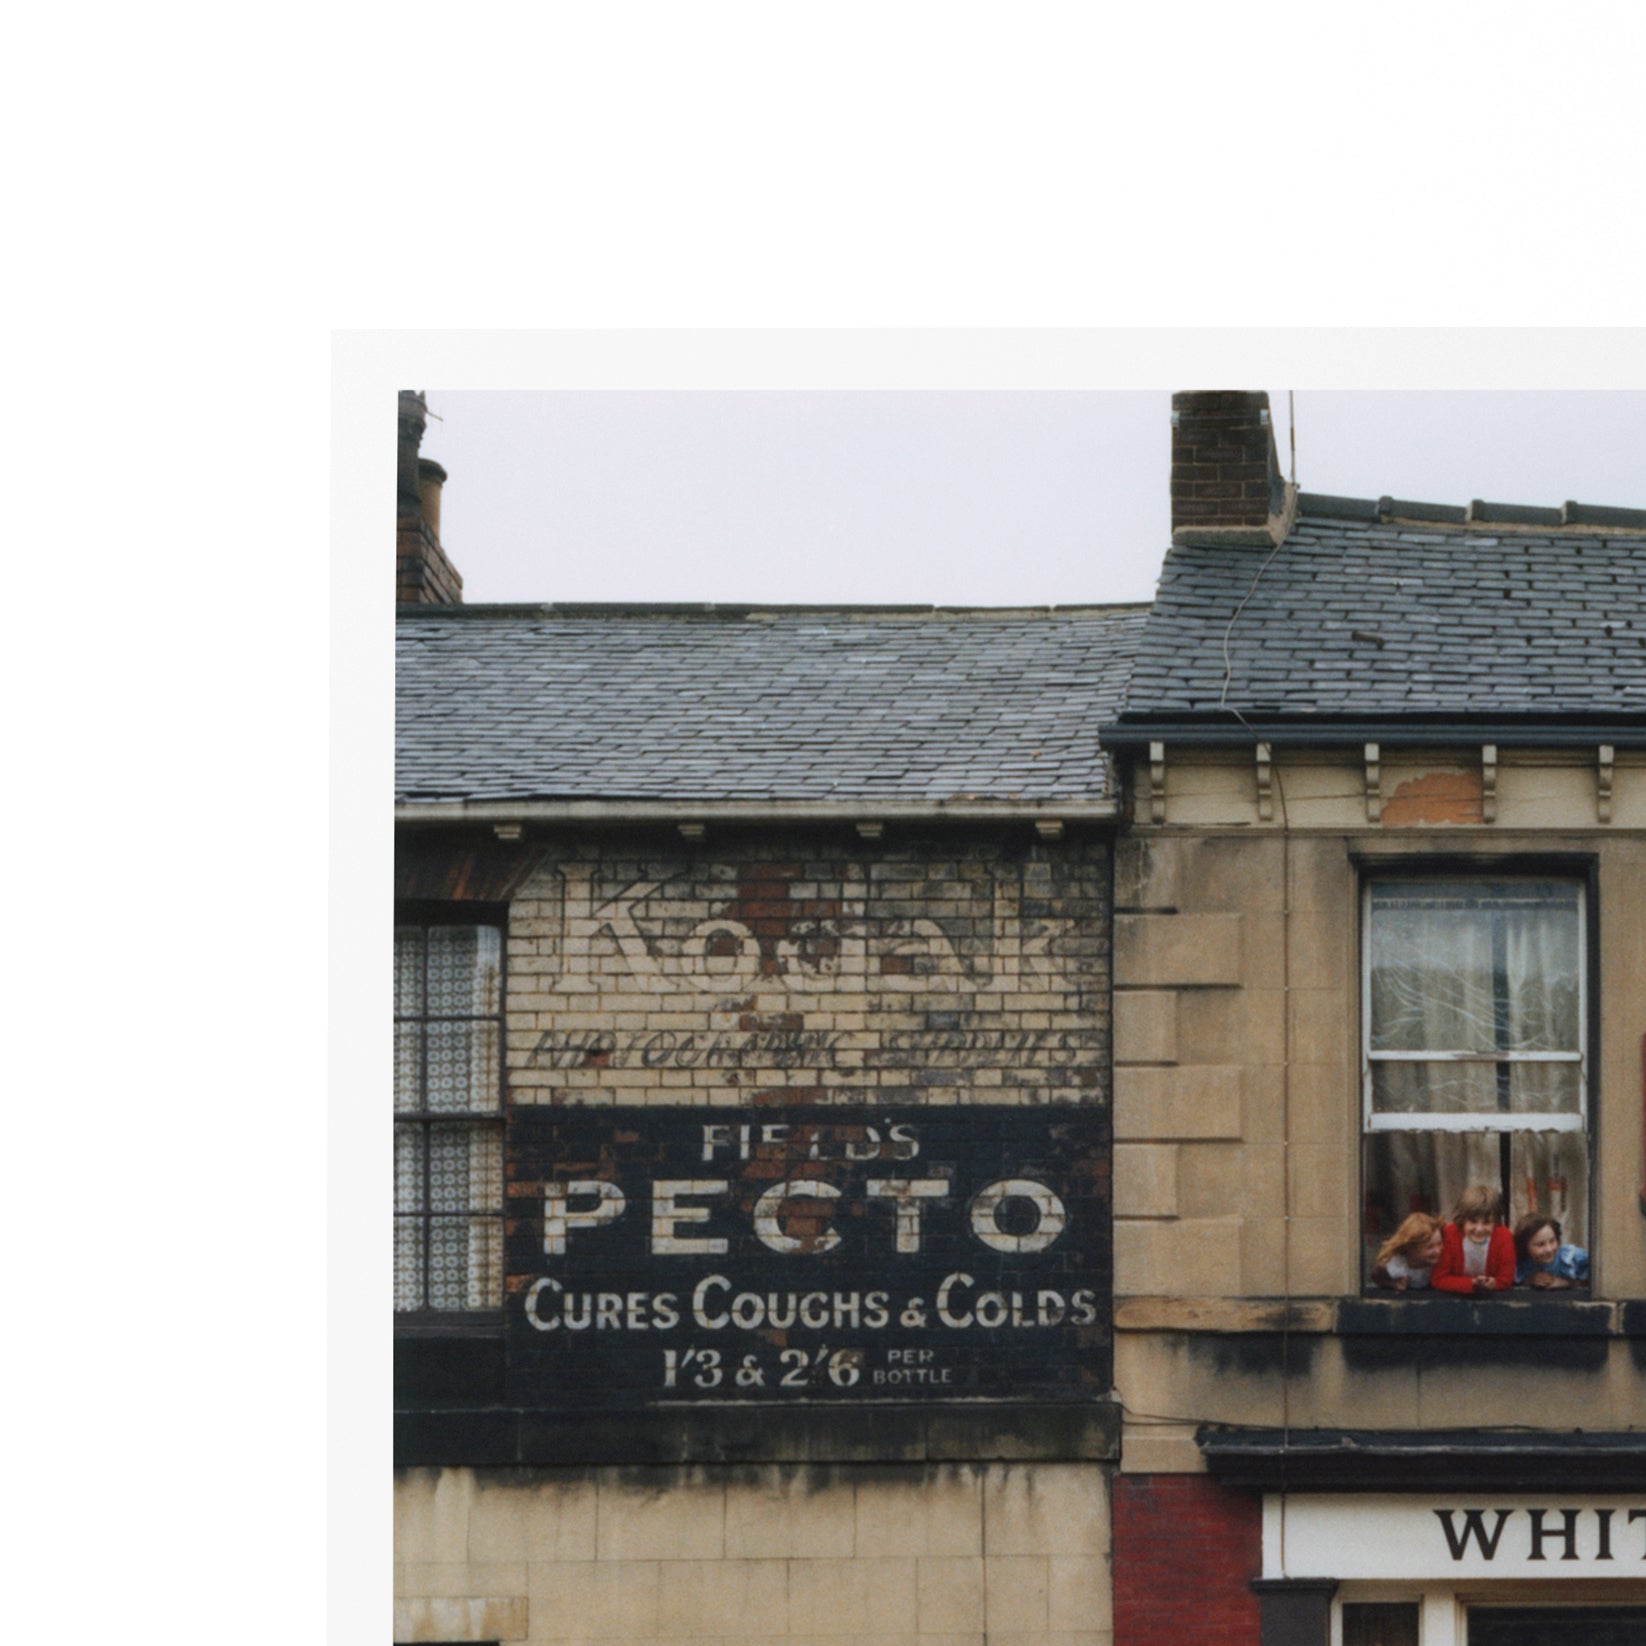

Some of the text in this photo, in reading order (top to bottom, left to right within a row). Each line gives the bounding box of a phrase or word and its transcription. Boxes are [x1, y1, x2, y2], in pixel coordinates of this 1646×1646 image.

[542, 1178, 1069, 1256] PECTO
[899, 1296, 925, 1330] &
[735, 1356, 766, 1387] &
[886, 1348, 935, 1366] PER
[872, 1369, 953, 1385] BOTTLE
